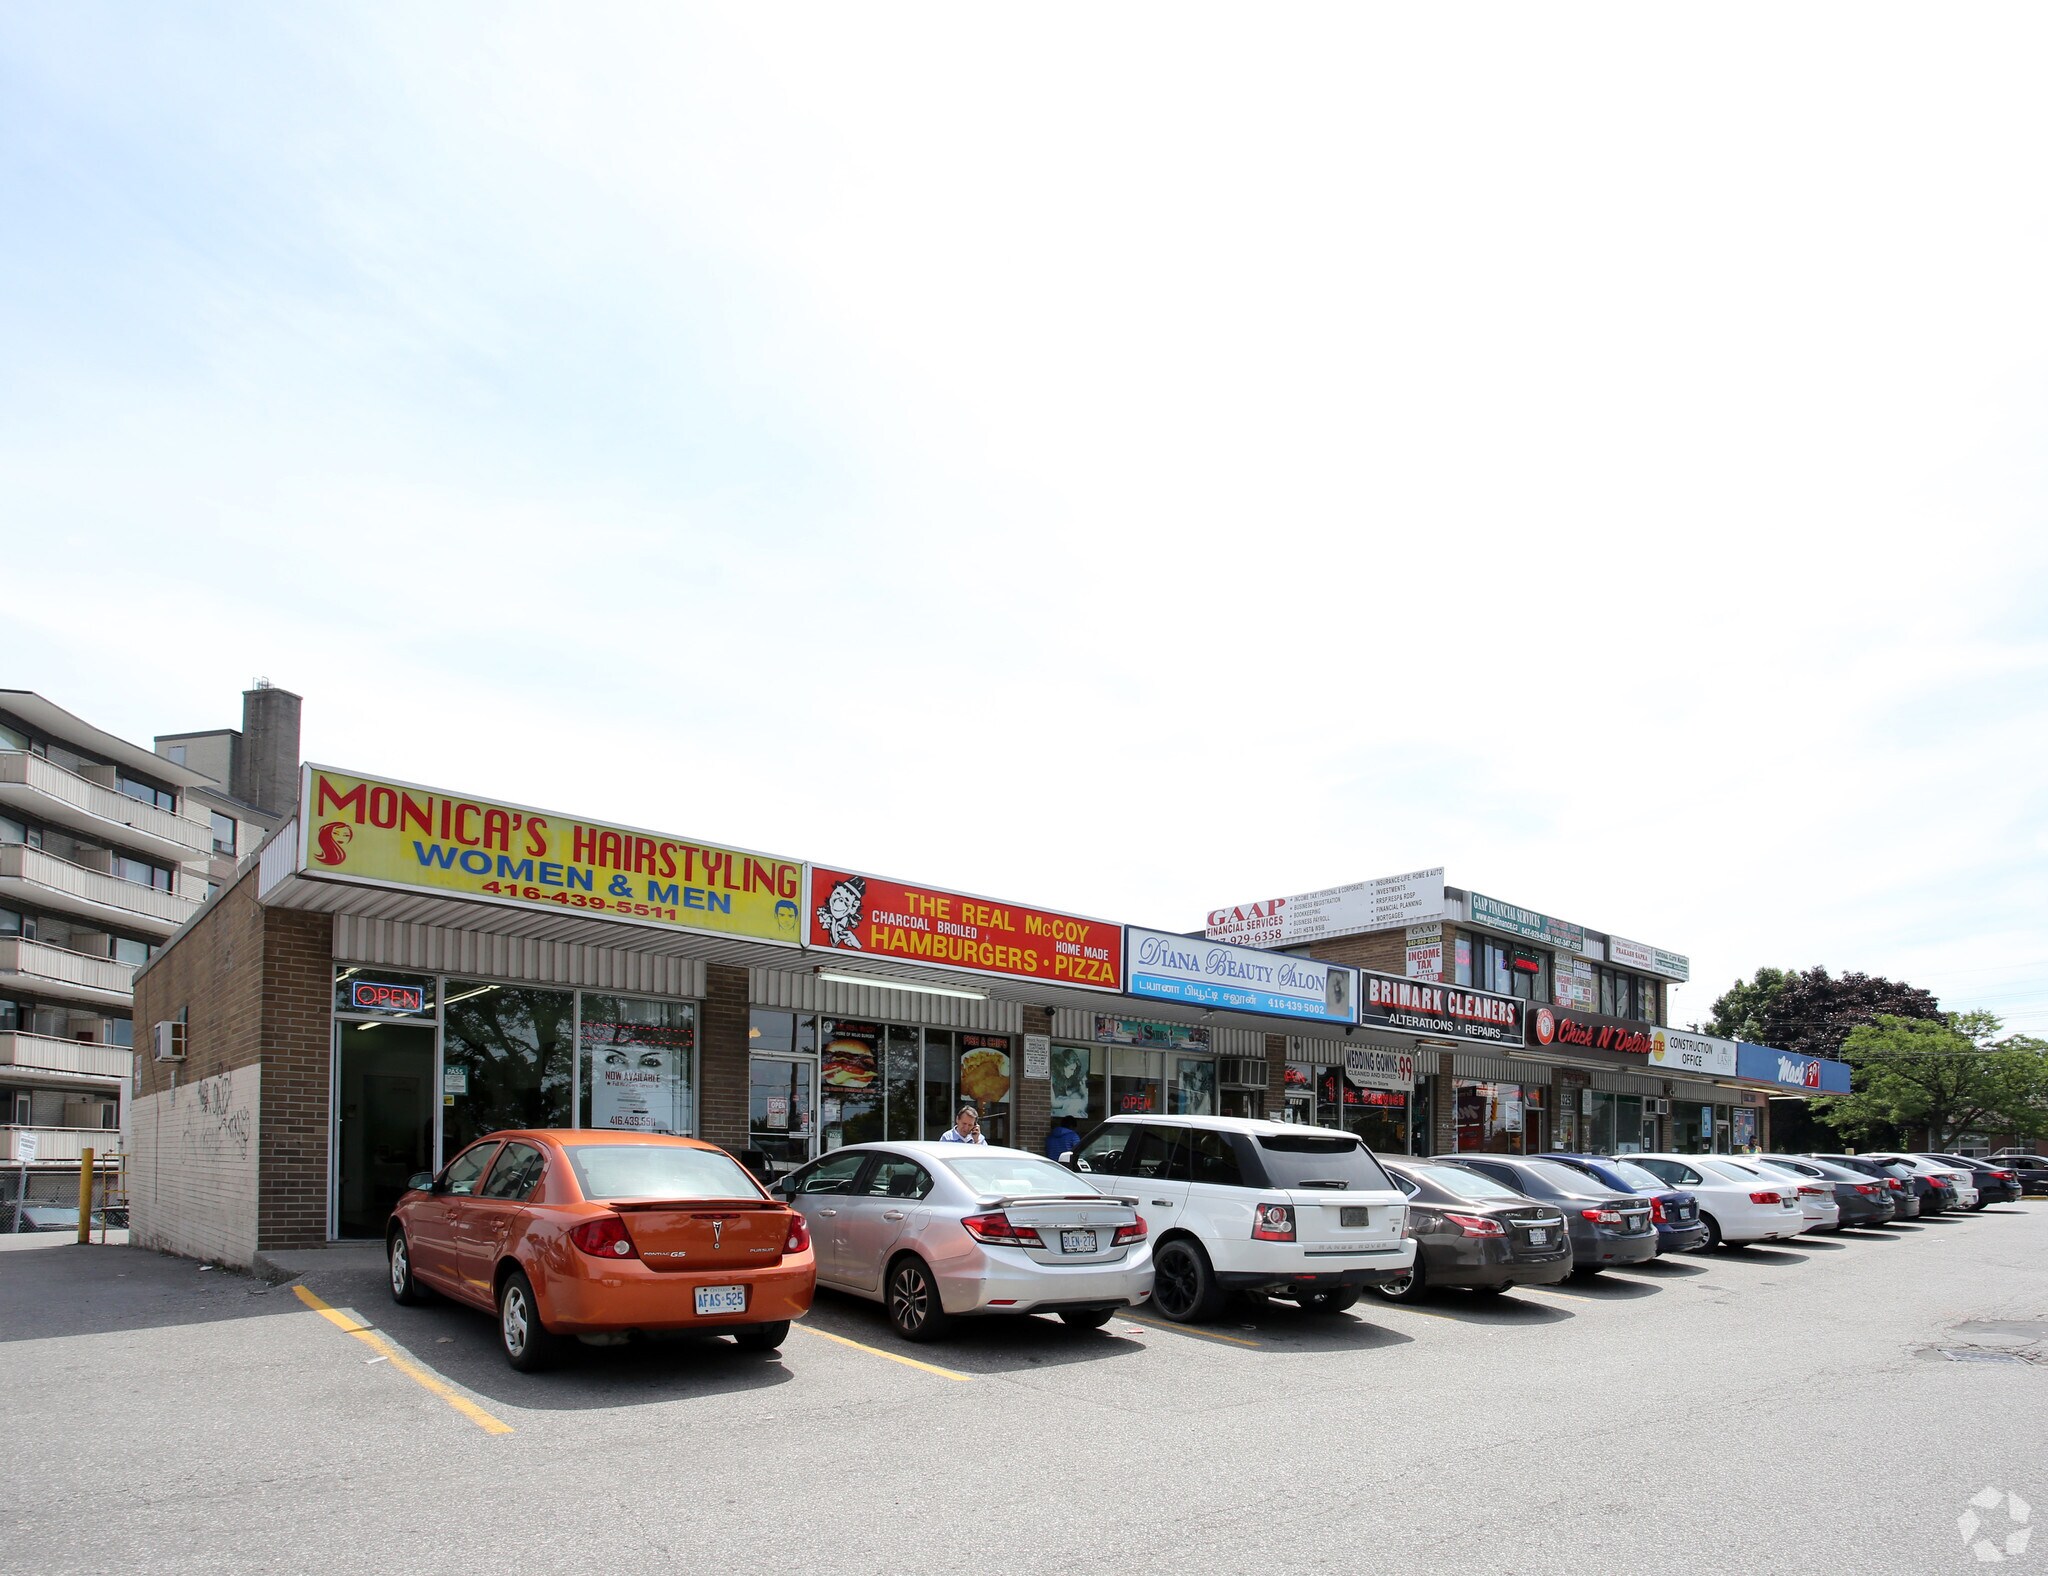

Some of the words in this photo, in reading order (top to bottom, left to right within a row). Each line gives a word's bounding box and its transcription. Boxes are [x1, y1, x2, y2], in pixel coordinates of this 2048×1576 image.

[318, 775, 548, 857] MONICA'S
[573, 825, 798, 898] HAIRSTYLING
[412, 840, 593, 891] WOMEN
[608, 873, 634, 898] &
[648, 881, 731, 914] MEN
[1430, 869, 1443, 877] AUTO
[1376, 884, 1406, 895] INVESTMENTS
[481, 880, 676, 920] 416-439-5511
[1294, 895, 1309, 903] INCOME
[1294, 902, 1313, 911] BUSINESS
[1314, 897, 1341, 907] REGISTRATION
[1376, 904, 1399, 913] FINANCIAL
[1400, 899, 1422, 909] PLANNING
[904, 892, 951, 920] THE
[962, 903, 1015, 932] REAL
[1025, 916, 1089, 943] McCOY
[1207, 898, 1286, 926] GAAP
[1294, 908, 1321, 918] BOOKKEEPING
[1376, 911, 1404, 921] MORTGAGES
[1473, 895, 1487, 913] GAAP
[1488, 900, 1516, 921] FINANCIAL
[1516, 908, 1541, 928] SERVICES
[872, 910, 930, 931] CHARCOAL
[937, 922, 977, 939] BROILED
[1207, 923, 1244, 937] FINANCIAL
[1247, 915, 1284, 930] SERVICES
[1293, 918, 1312, 927] BUSINESS
[1313, 915, 1330, 923] PAYROLL
[1411, 925, 1437, 935] GAAP
[870, 925, 1038, 972] HAMBURGERS
[1055, 954, 1115, 984] PIZZA
[1056, 940, 1081, 956] HOME
[1084, 946, 1109, 961] MADE
[1408, 948, 1440, 961] INCOME
[1138, 937, 1200, 972] DIANA
[1205, 948, 1273, 983] BEAUTY
[1277, 963, 1325, 992] SALON
[1417, 959, 1432, 970] TAX
[357, 985, 419, 1009] OPEN
[1369, 978, 1443, 1013] BRIMARK
[1448, 991, 1516, 1025] CLEANERS
[1388, 1013, 1453, 1031] ALTERATIONS
[1465, 1024, 1501, 1039] REPAIRS
[1558, 1018, 1593, 1047] Chick
[1597, 1026, 1616, 1049] N
[962, 1034, 980, 1046] FISH
[980, 1036, 987, 1046] &
[987, 1037, 1008, 1049] CHIPS
[1669, 1037, 1713, 1055] CONSTRUCTION
[1346, 1049, 1374, 1071] WEDDING
[1375, 1052, 1397, 1073] GOWNS
[1682, 1053, 1702, 1066] OFFICE
[605, 1071, 622, 1080] NOW
[623, 1072, 660, 1082] AVAILABLE
[1284, 1069, 1307, 1084] PEN
[771, 1101, 786, 1109] OPEN
[1122, 1095, 1151, 1110] OPEN
[698, 1293, 721, 1307] AFAS
[725, 1291, 743, 1306] 525
